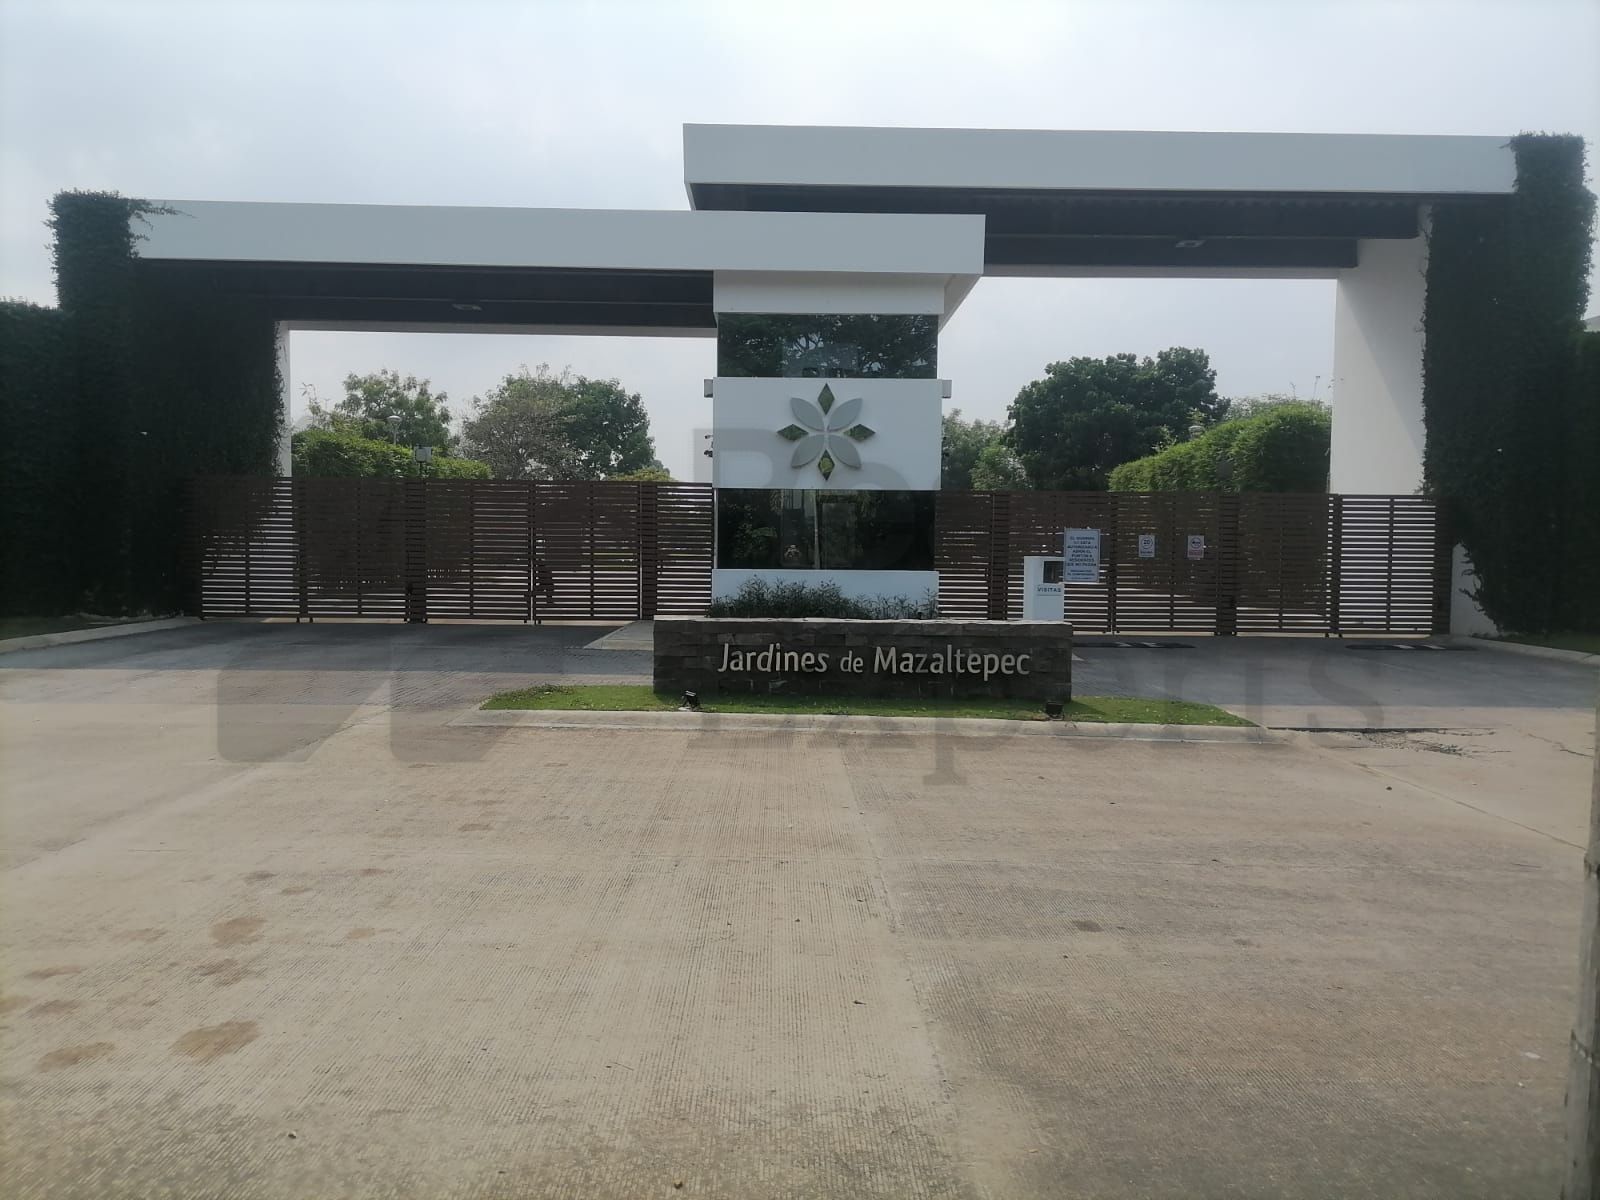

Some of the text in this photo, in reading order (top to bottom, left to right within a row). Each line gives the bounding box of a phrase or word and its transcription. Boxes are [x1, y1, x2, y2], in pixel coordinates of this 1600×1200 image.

[717, 642, 1031, 682] Jardines de Mazaltepec
